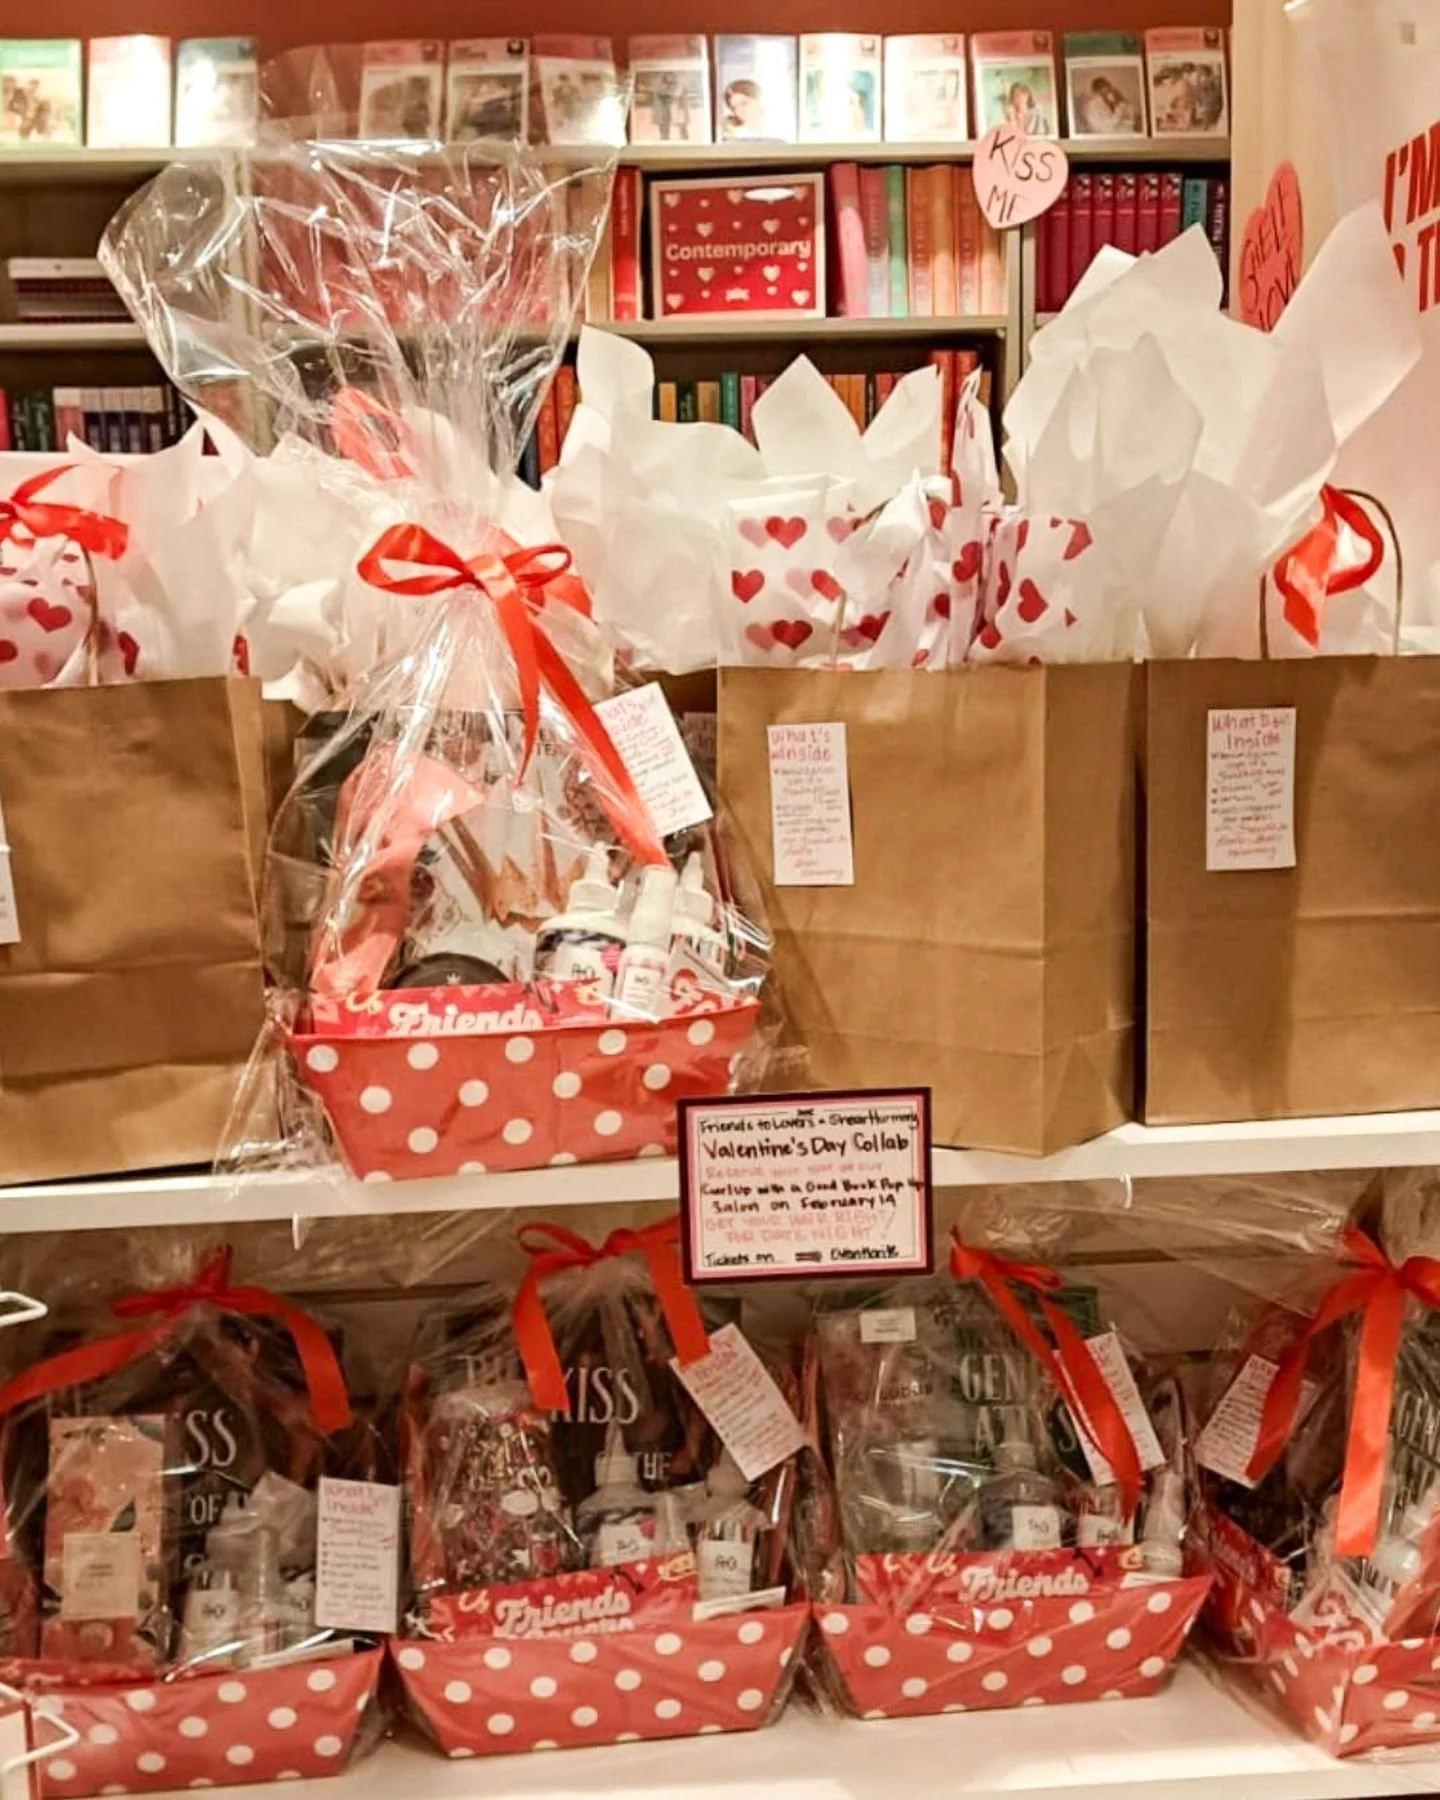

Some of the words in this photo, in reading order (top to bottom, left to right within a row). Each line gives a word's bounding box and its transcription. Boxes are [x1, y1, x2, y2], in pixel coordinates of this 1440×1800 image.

[989, 130, 1056, 183] KISS
[665, 240, 811, 260] Contemporary
[386, 1003, 544, 1037] Friends
[700, 1119, 753, 1133] Friends
[703, 1136, 808, 1159] Valentine's
[811, 1136, 846, 1157] Day
[853, 1132, 909, 1153] Collab
[842, 1179, 876, 1192] Book
[880, 1178, 904, 1192] Pop
[713, 1201, 760, 1214] Salon
[770, 1201, 791, 1211] on
[801, 1195, 875, 1210] February
[879, 1194, 896, 1208] 14
[958, 1566, 1089, 1602] Friends
[494, 1586, 631, 1634] Friends
